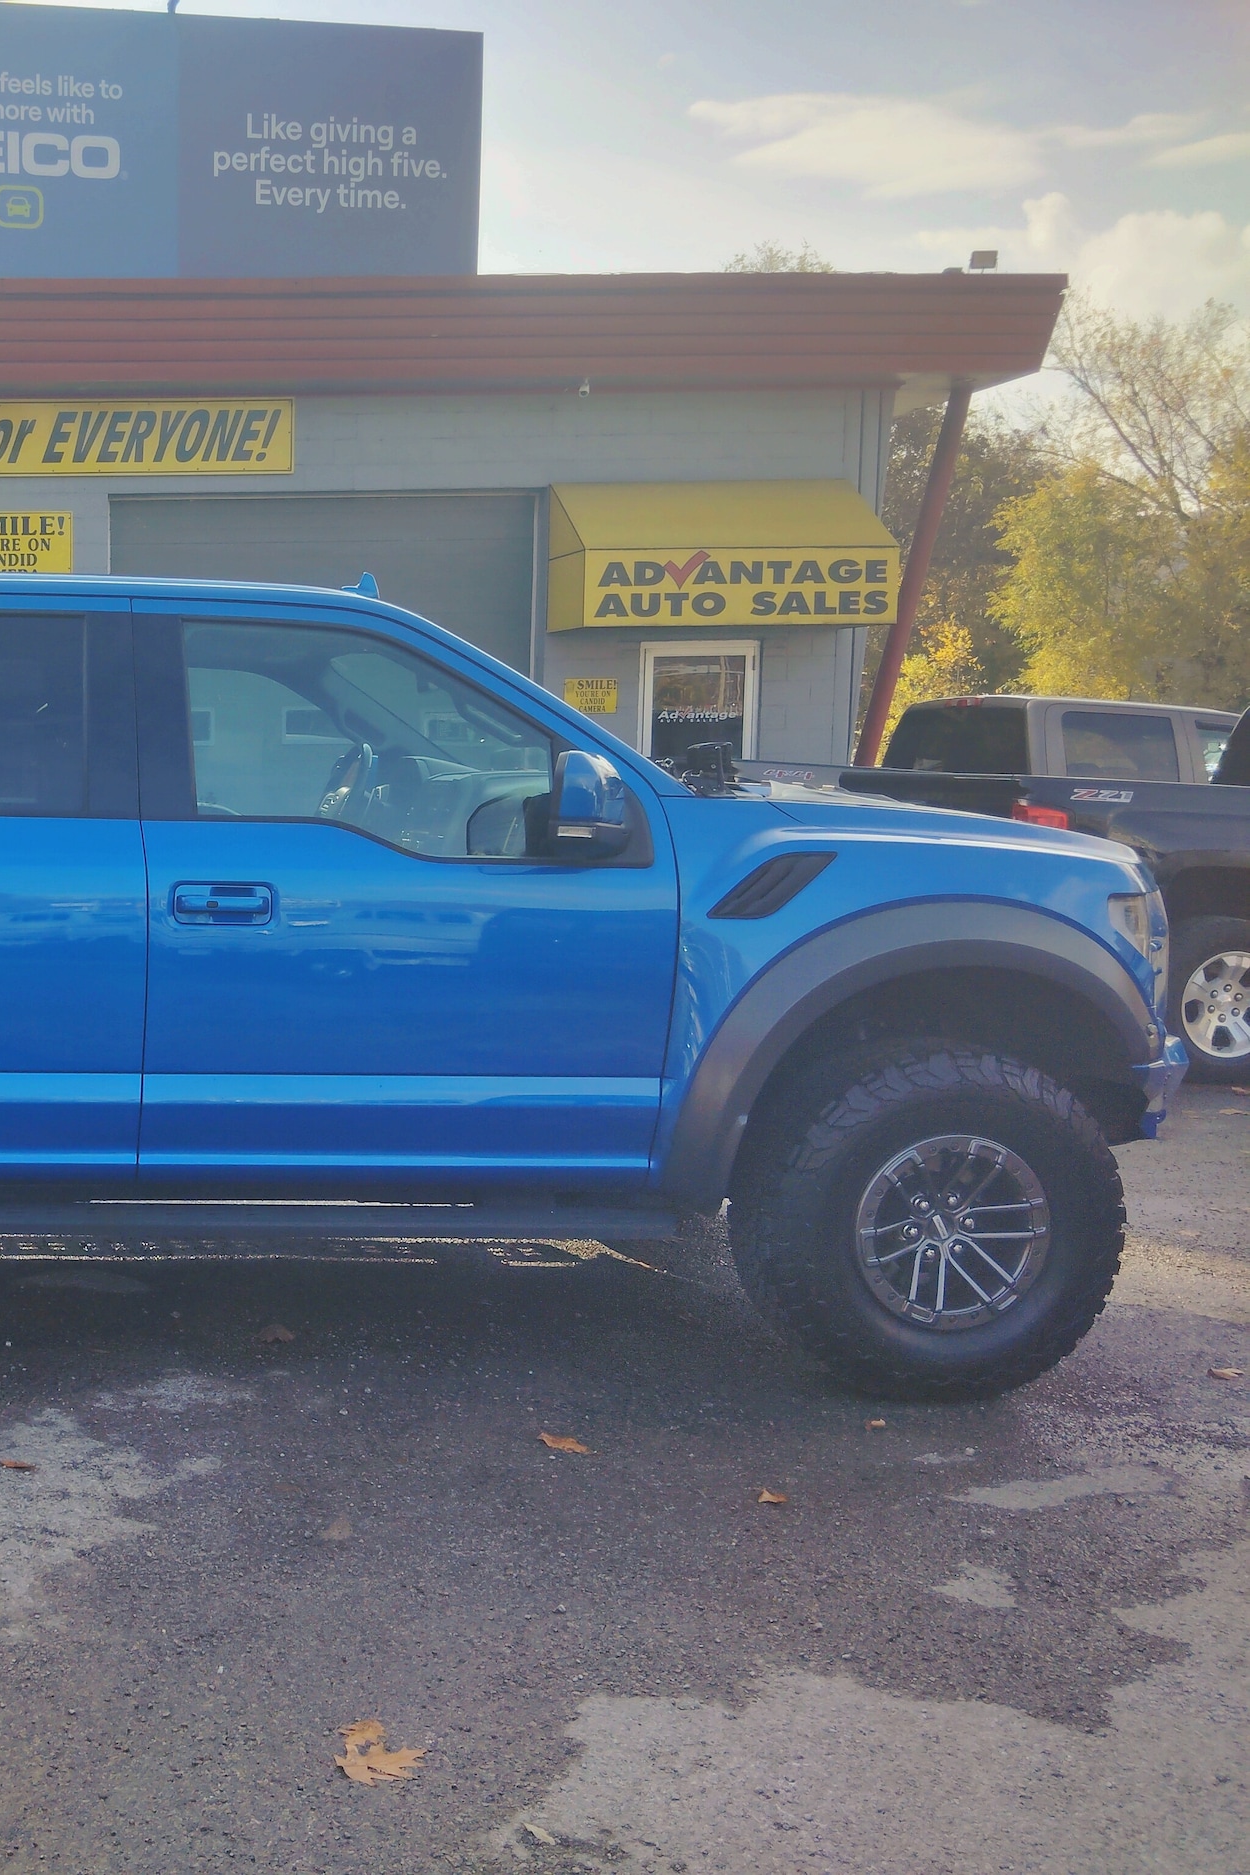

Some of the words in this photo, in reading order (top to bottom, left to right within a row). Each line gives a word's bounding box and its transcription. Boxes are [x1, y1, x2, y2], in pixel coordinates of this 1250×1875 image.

[57, 75, 95, 98] like
[99, 79, 123, 100] to
[46, 102, 95, 124] with
[246, 113, 302, 141] Like
[310, 116, 394, 150] giving
[401, 125, 417, 145] a
[213, 146, 316, 177] perfect
[323, 148, 383, 183] high
[390, 151, 448, 179] five.
[255, 179, 331, 214] Every
[336, 182, 407, 210] time.
[41, 408, 282, 464] EVERYONE!
[28, 538, 51, 551] ON
[593, 592, 727, 618] AUTO
[750, 590, 889, 616] SALES
[577, 680, 617, 690] SMILE!
[1070, 788, 1134, 803] Z71
